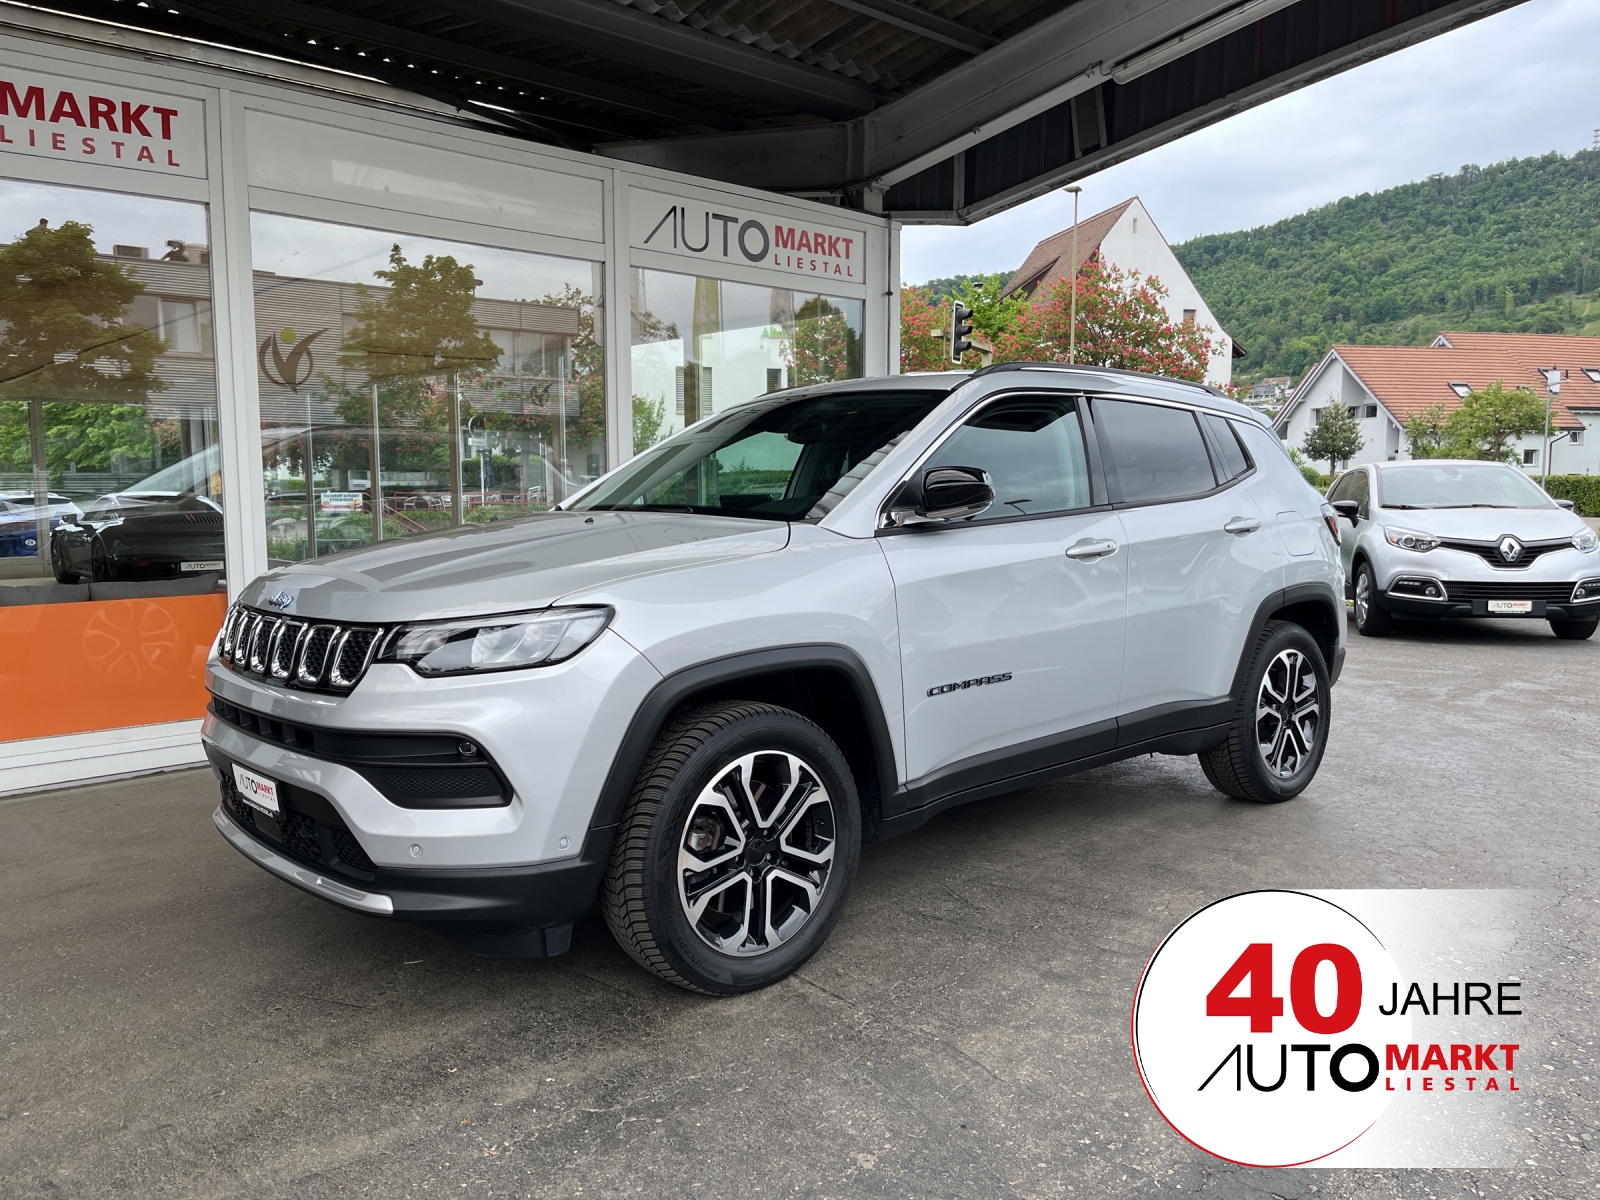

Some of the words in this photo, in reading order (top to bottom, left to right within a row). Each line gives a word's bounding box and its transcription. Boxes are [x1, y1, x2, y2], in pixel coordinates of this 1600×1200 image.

[0, 80, 178, 140] MARKT
[0, 125, 180, 167] LIESTAL
[774, 225, 853, 260] MARKT
[774, 253, 853, 277] LIESTAL
[927, 672, 1012, 697] COMPASS
